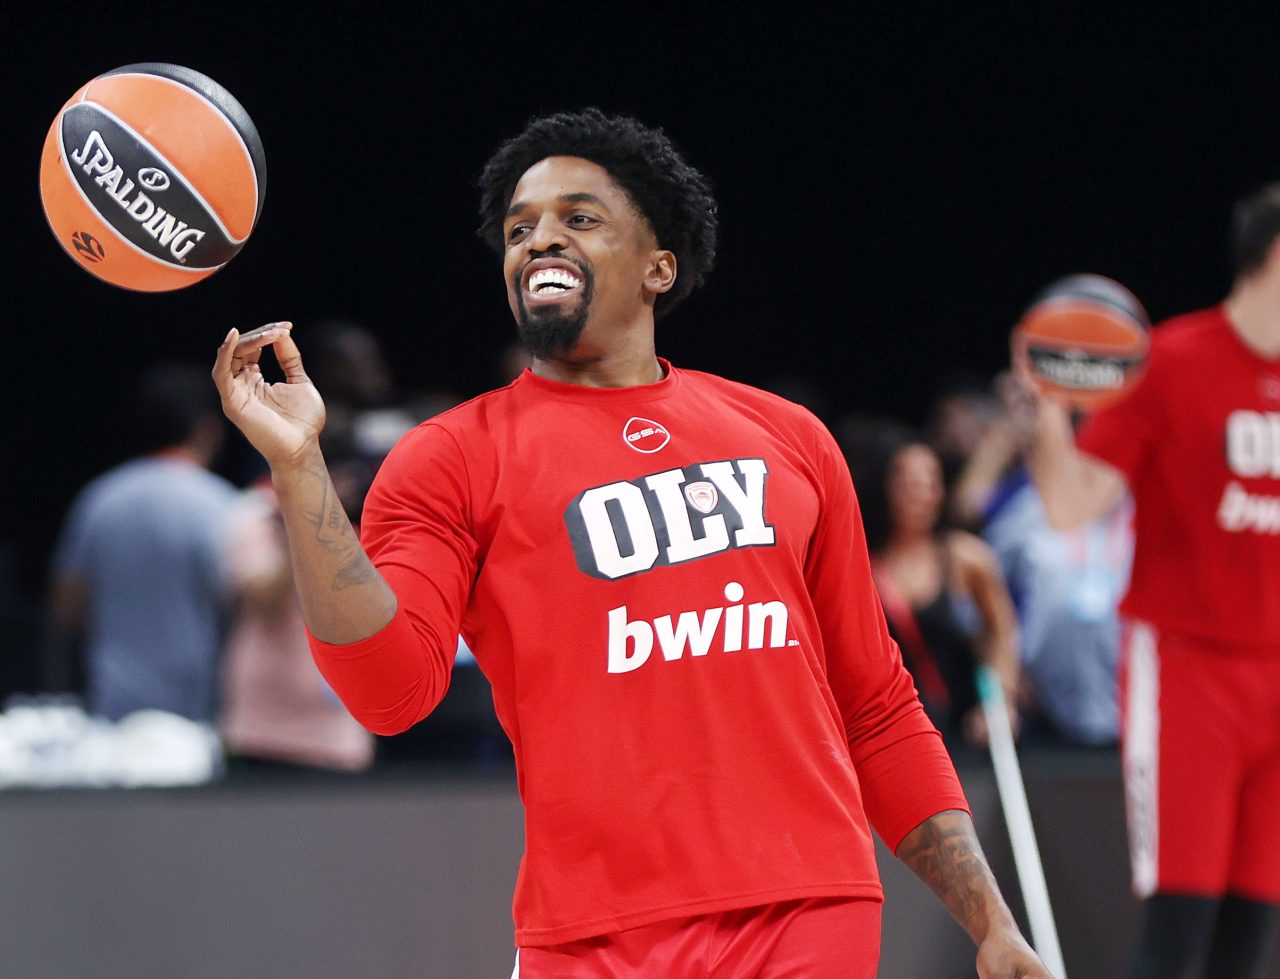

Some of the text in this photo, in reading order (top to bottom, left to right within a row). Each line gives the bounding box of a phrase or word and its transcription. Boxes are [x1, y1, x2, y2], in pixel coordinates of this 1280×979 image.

[70, 130, 207, 262] SPALDING
[627, 428, 667, 442] GSA
[577, 458, 775, 579] OLY
[607, 582, 788, 673] bwin
